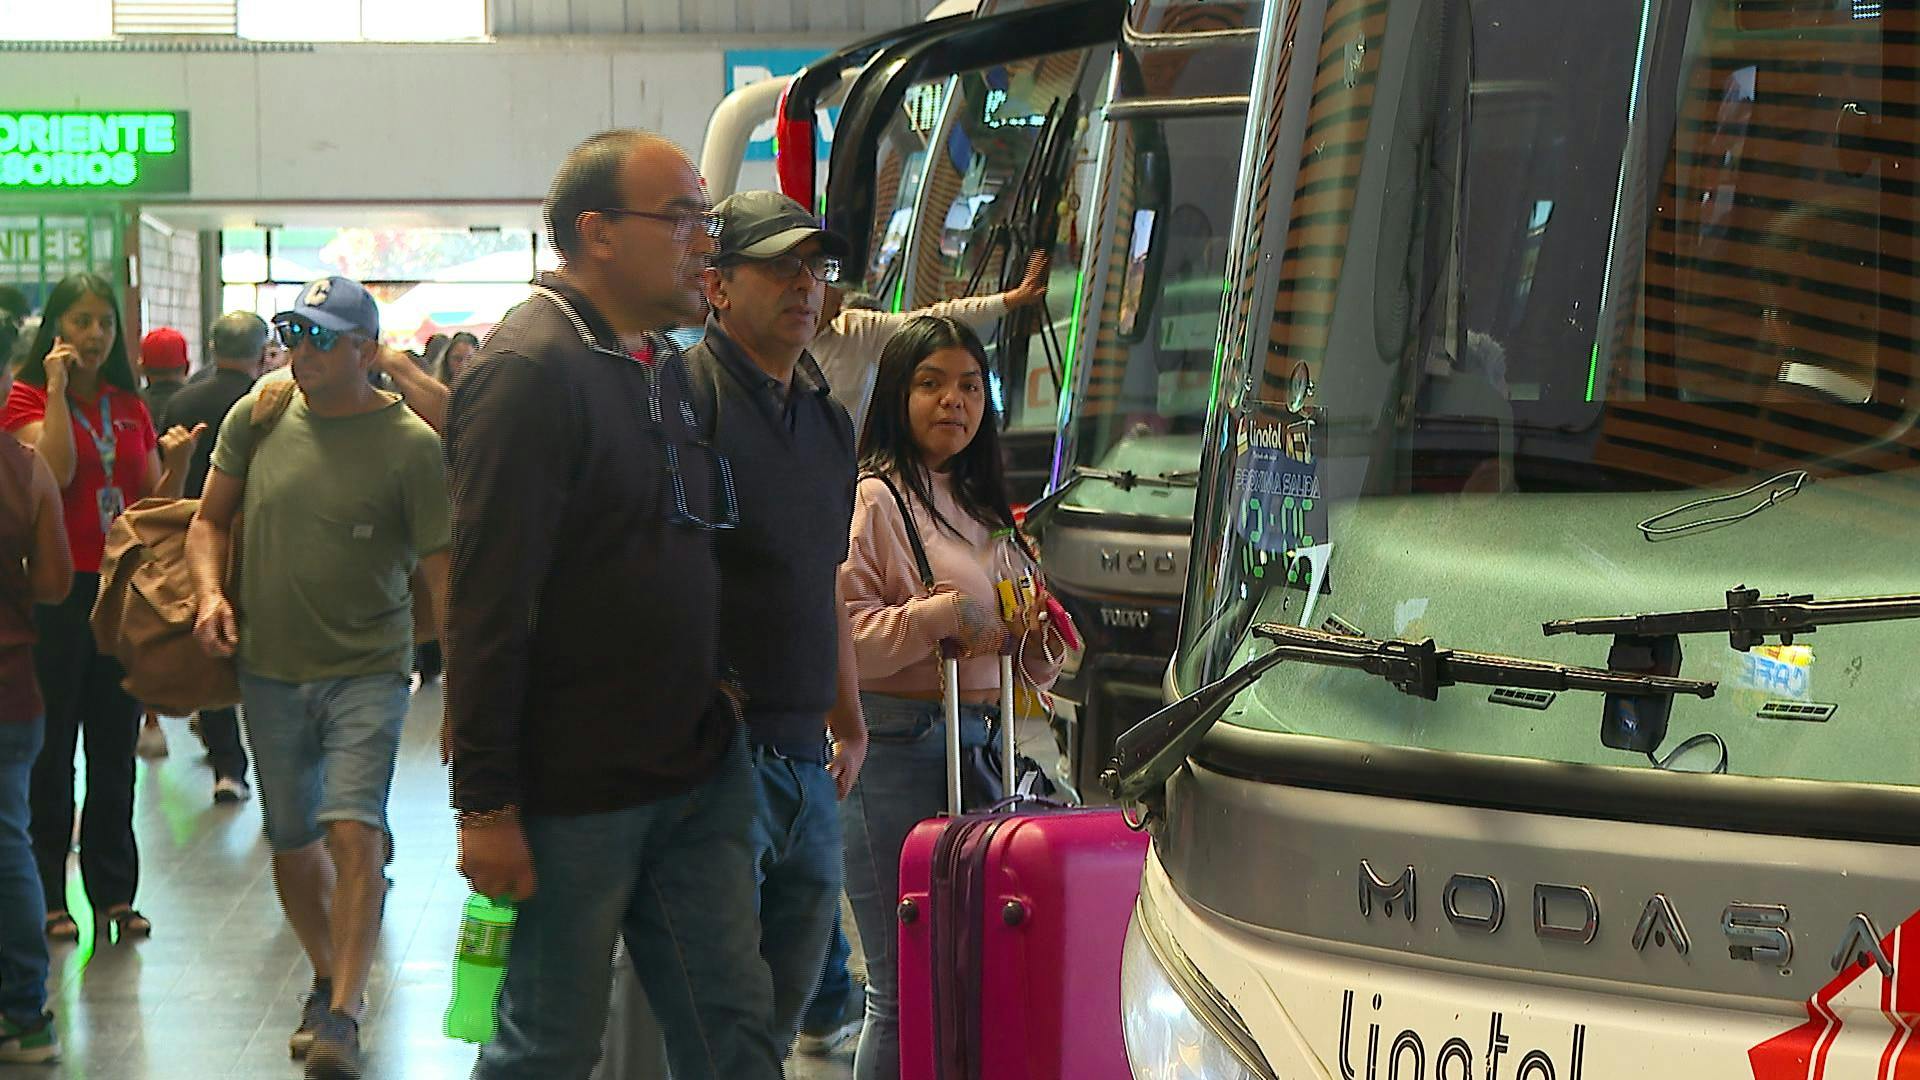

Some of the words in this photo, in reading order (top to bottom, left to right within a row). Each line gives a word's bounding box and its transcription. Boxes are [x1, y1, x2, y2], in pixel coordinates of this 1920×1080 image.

[0, 113, 175, 152] ORIENTE
[0, 152, 138, 186] SORIOS
[1282, 472, 1321, 499] SALIDA
[1358, 858, 1894, 978] MODASA
